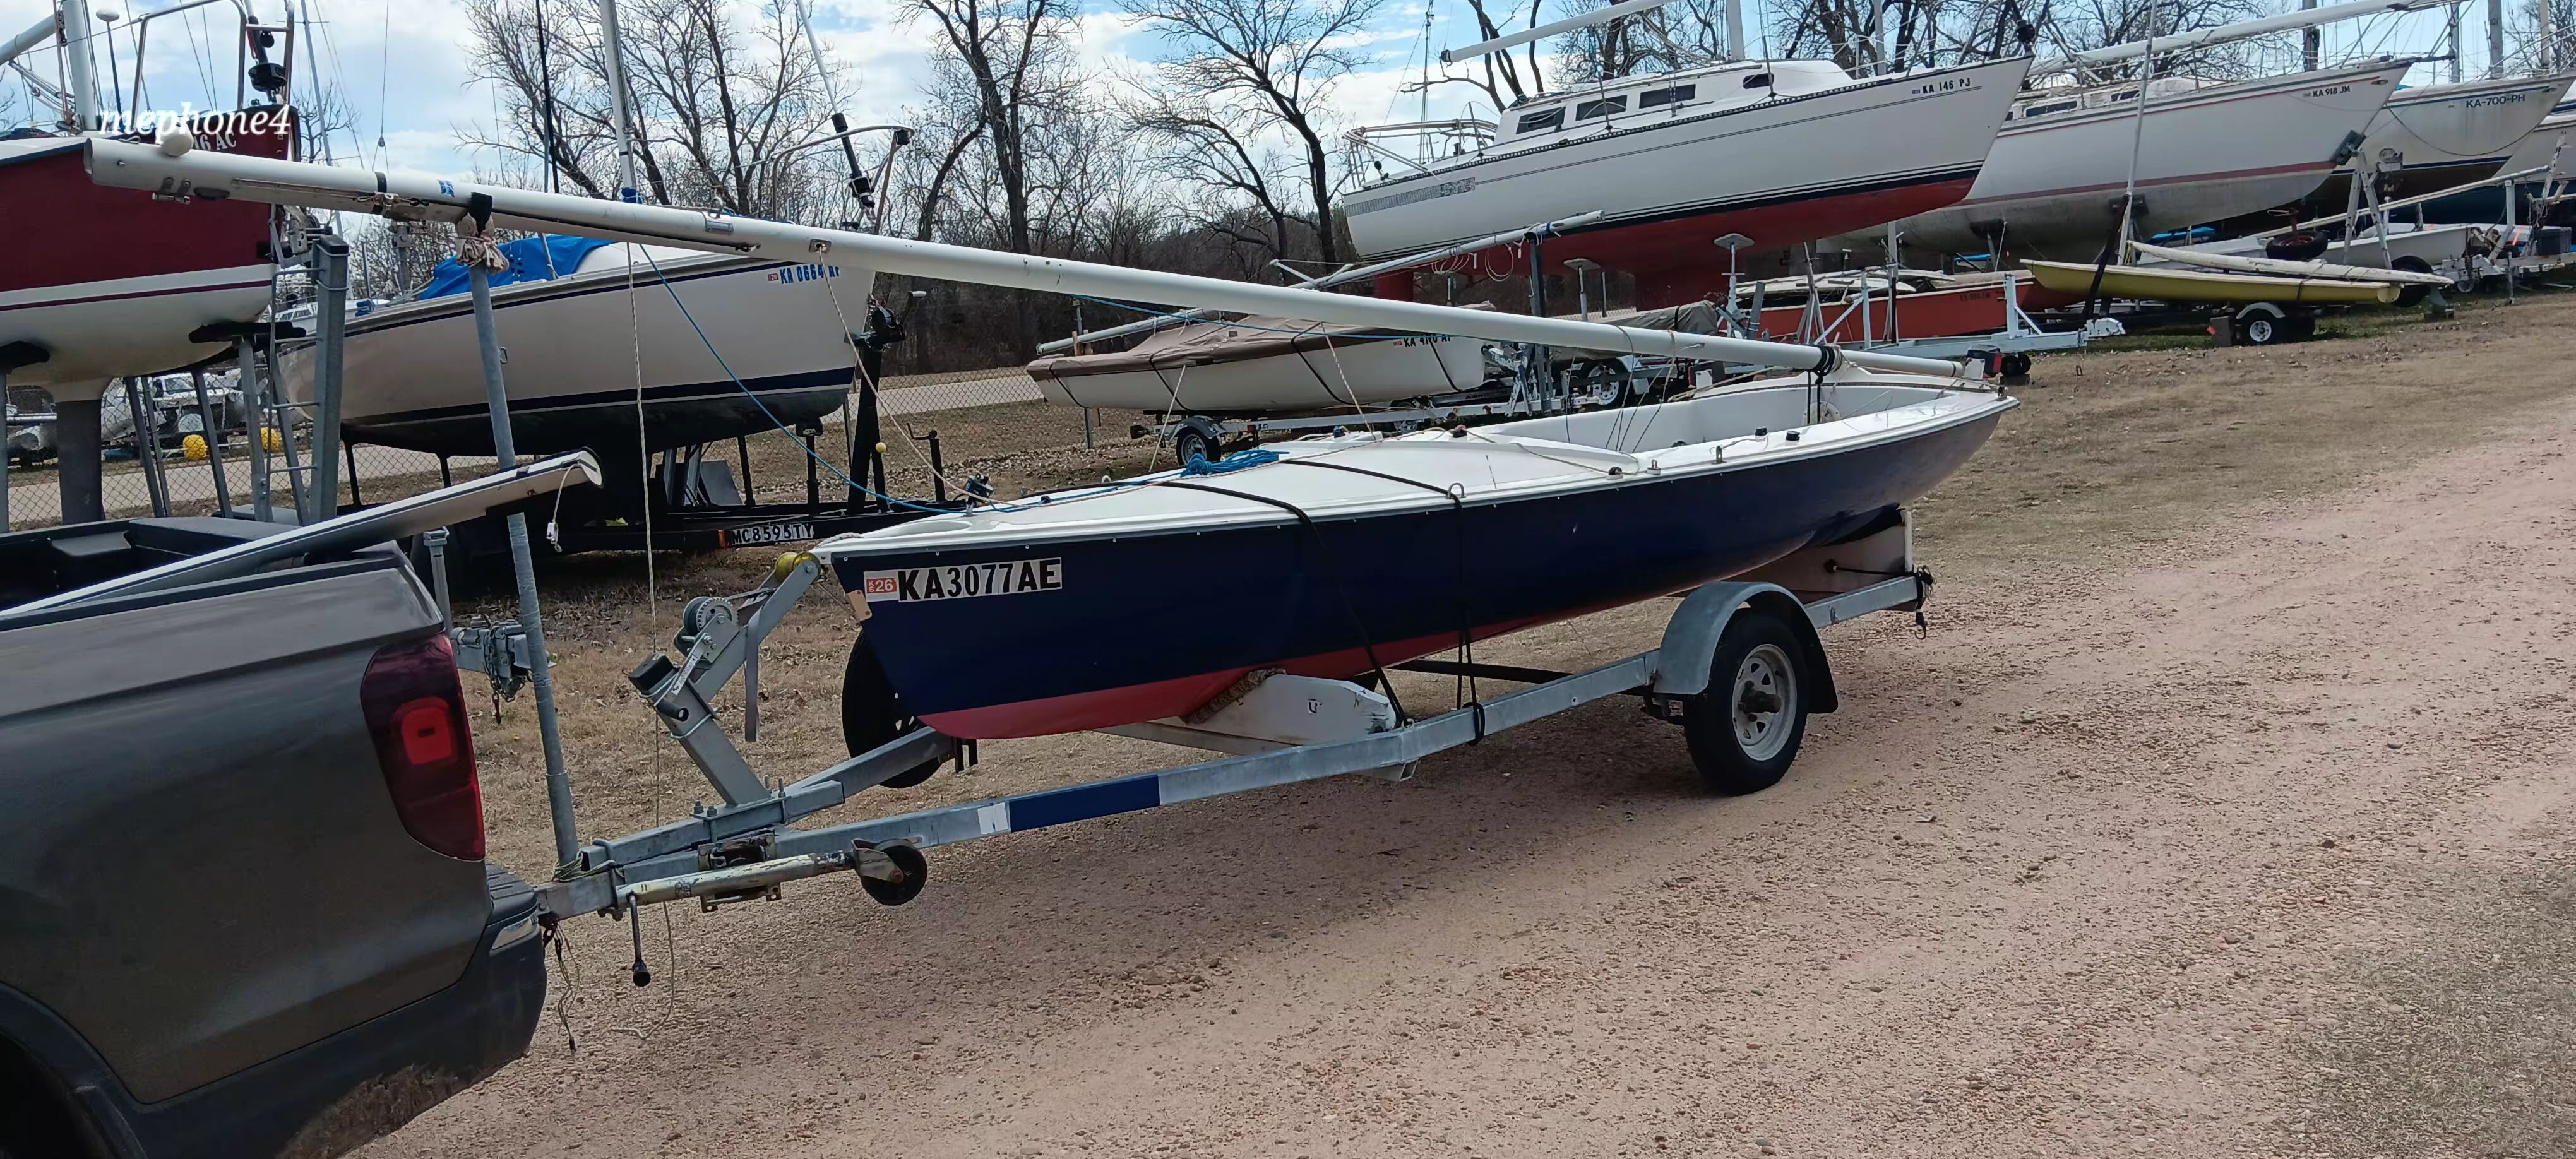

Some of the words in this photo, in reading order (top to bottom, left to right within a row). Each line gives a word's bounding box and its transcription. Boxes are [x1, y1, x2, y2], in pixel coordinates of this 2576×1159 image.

[1923, 85, 1934, 94] KA
[1939, 80, 1953, 91] 146
[1959, 78, 1970, 87] PJ
[2466, 94, 2525, 108] KA-700-PH
[780, 268, 794, 284] KA
[796, 264, 824, 282] 0664
[1404, 338, 1416, 347] KA
[732, 524, 814, 544] MC8595TY
[875, 579, 893, 591] 26
[898, 559, 1061, 601] KA3077AE
